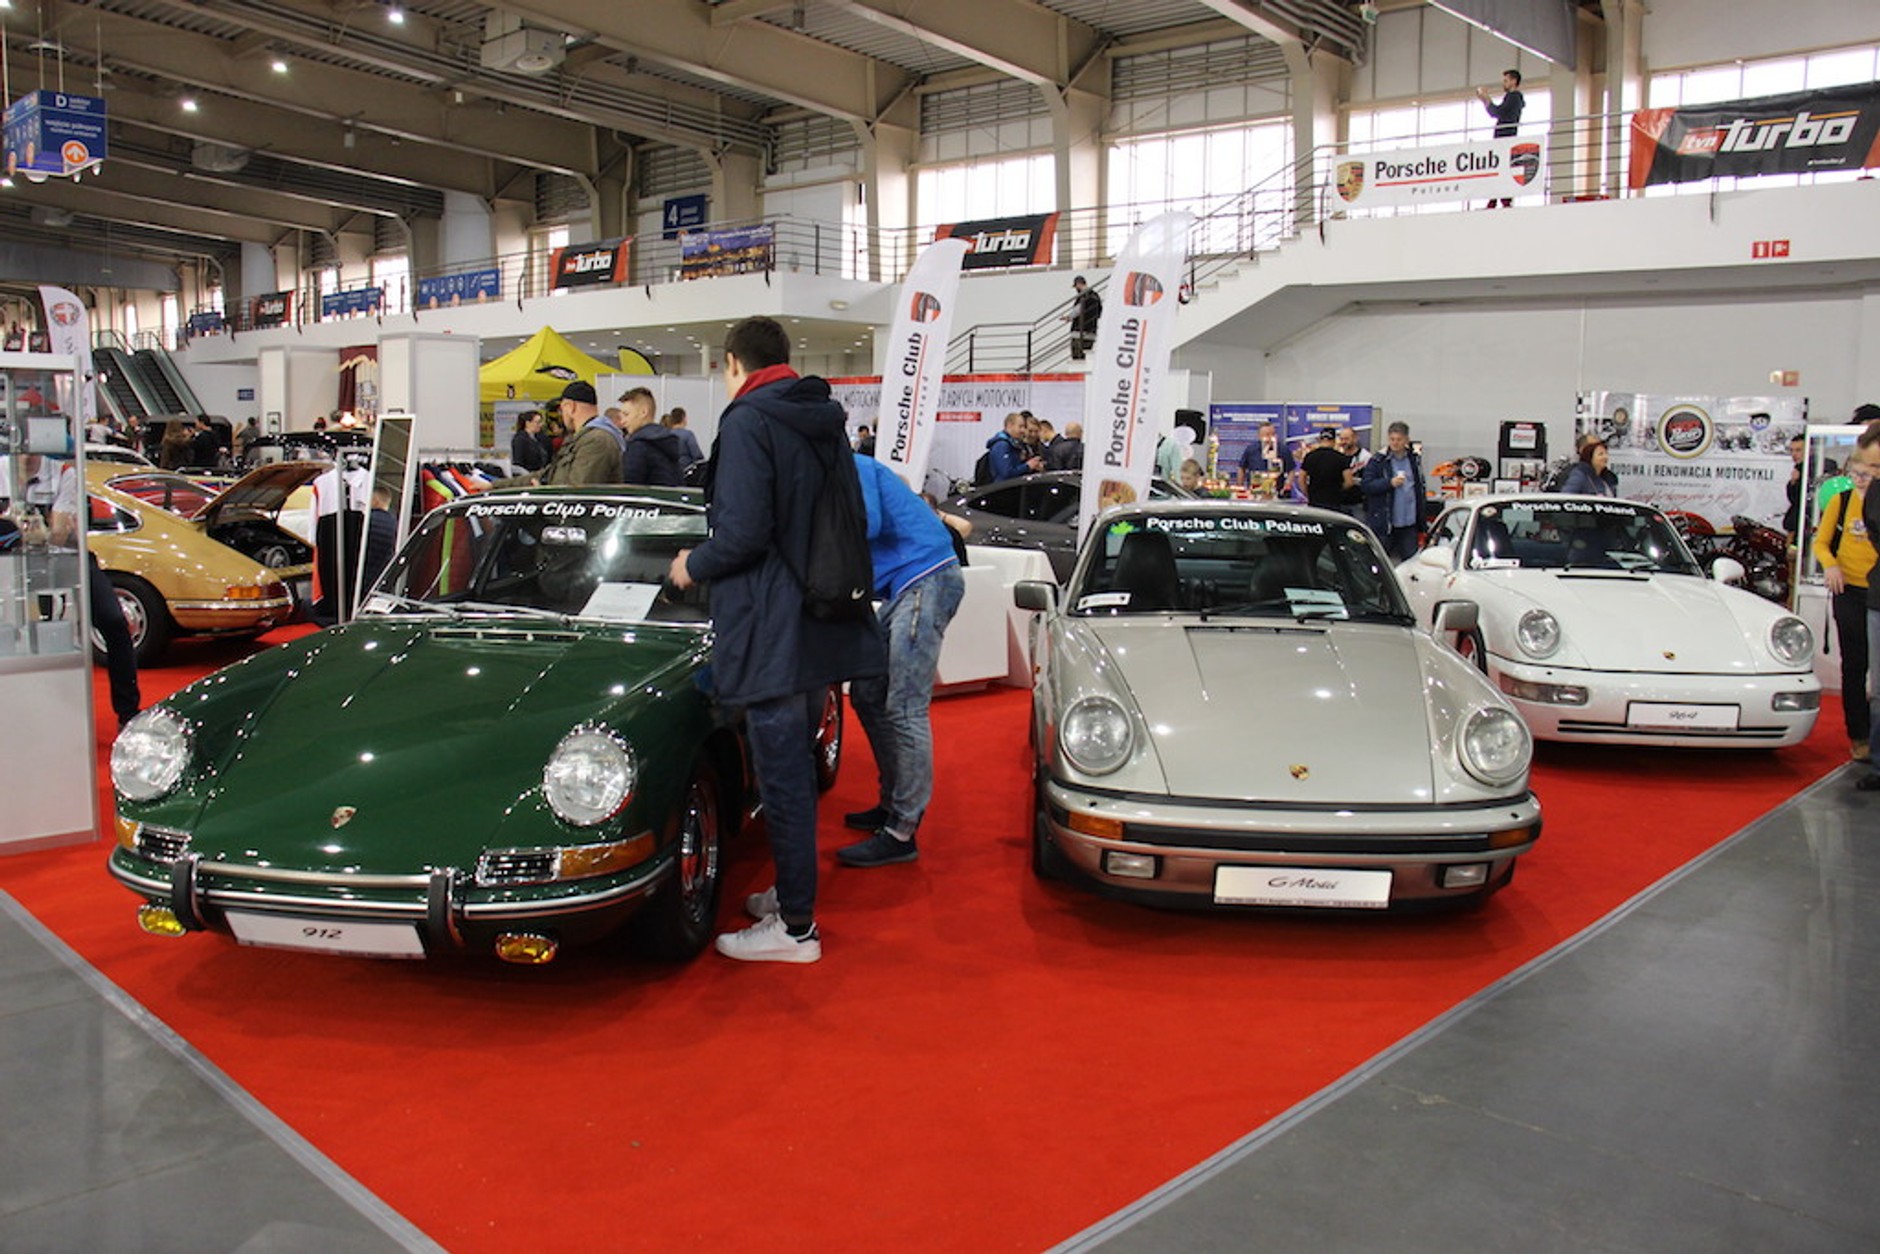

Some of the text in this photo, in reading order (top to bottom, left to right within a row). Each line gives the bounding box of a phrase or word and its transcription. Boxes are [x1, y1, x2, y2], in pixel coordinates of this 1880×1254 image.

[55, 94, 68, 108] D
[1685, 110, 1861, 152] tvn turbo
[1374, 150, 1500, 180] Porsche Club
[1411, 184, 1460, 195] Poland
[668, 204, 678, 226] 4
[971, 229, 1032, 253] turbo
[574, 250, 613, 272] turbo
[890, 332, 922, 463] Porsche Club
[1104, 317, 1140, 468] Porsche Club
[1653, 464, 1712, 479] RENOWACJA
[1715, 465, 1774, 481] MOTOCYKLI
[465, 502, 660, 520] Porsche Club Poland
[1512, 502, 1636, 516] Porsche Club Poland
[1146, 517, 1324, 535] Porsche Club Poland
[1267, 875, 1289, 888] G
[302, 926, 344, 940] 912
